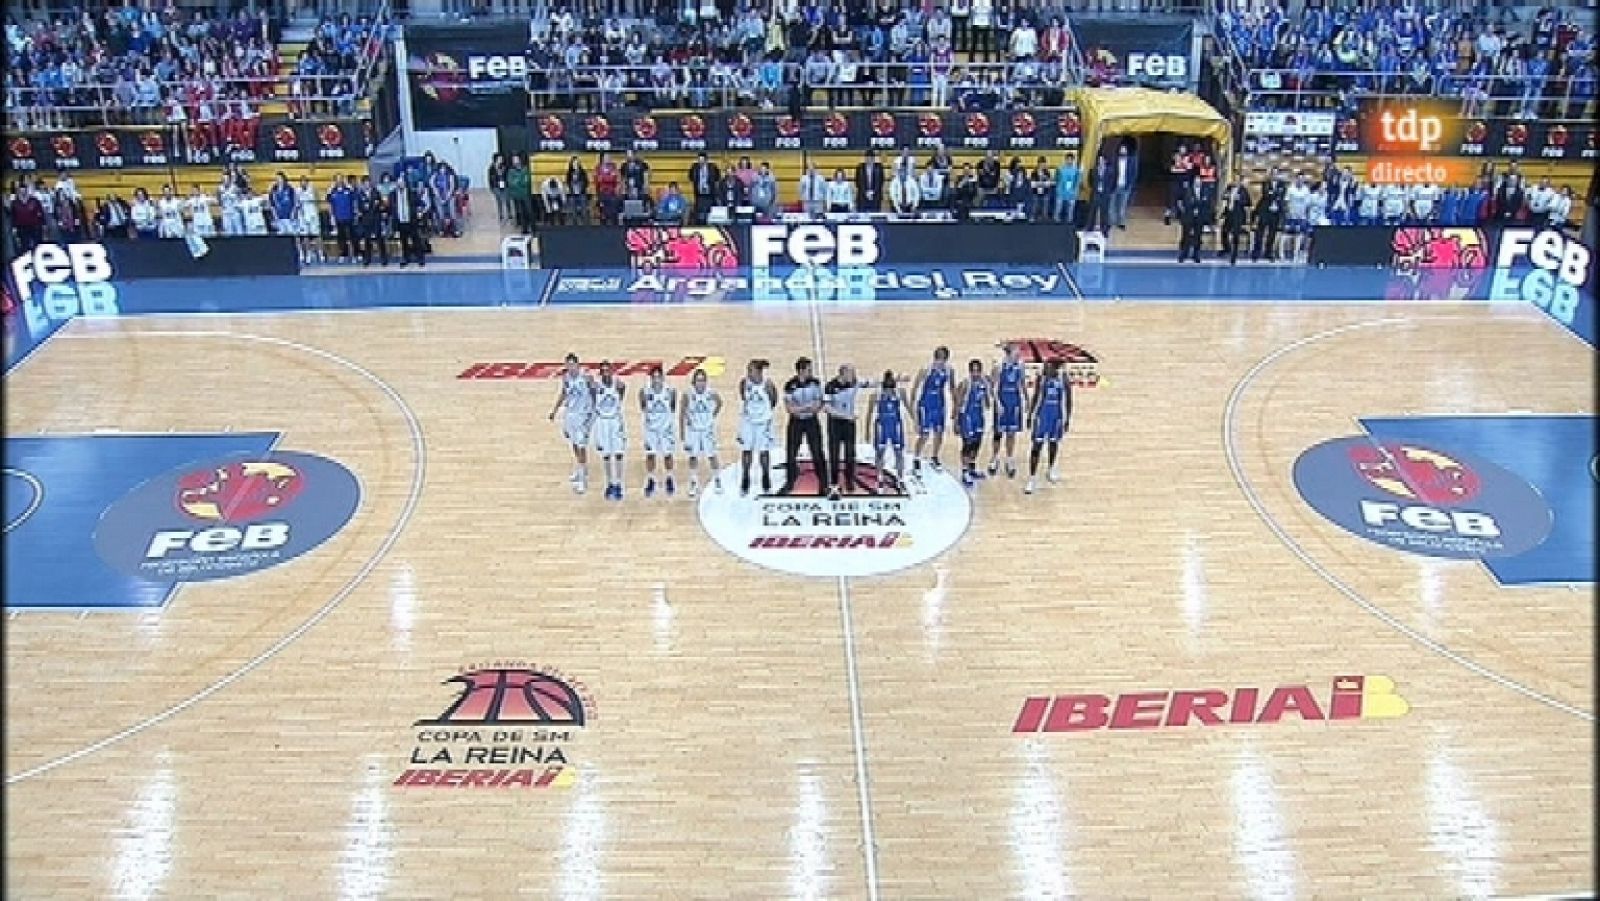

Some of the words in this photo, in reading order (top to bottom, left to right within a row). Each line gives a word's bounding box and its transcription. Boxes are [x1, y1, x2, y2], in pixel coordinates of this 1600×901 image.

[868, 270, 946, 293] del
[961, 270, 1059, 293] Rey
[762, 502, 822, 513] COPA
[763, 512, 802, 527] LA
[812, 512, 907, 527] REINA
[749, 533, 876, 549] IBERIA
[1012, 683, 1325, 732] IBERIA
[416, 730, 483, 744] COPA
[493, 730, 525, 744] DE
[409, 746, 454, 765] LA
[464, 746, 568, 765] REINA
[391, 768, 535, 788] IBERIA
